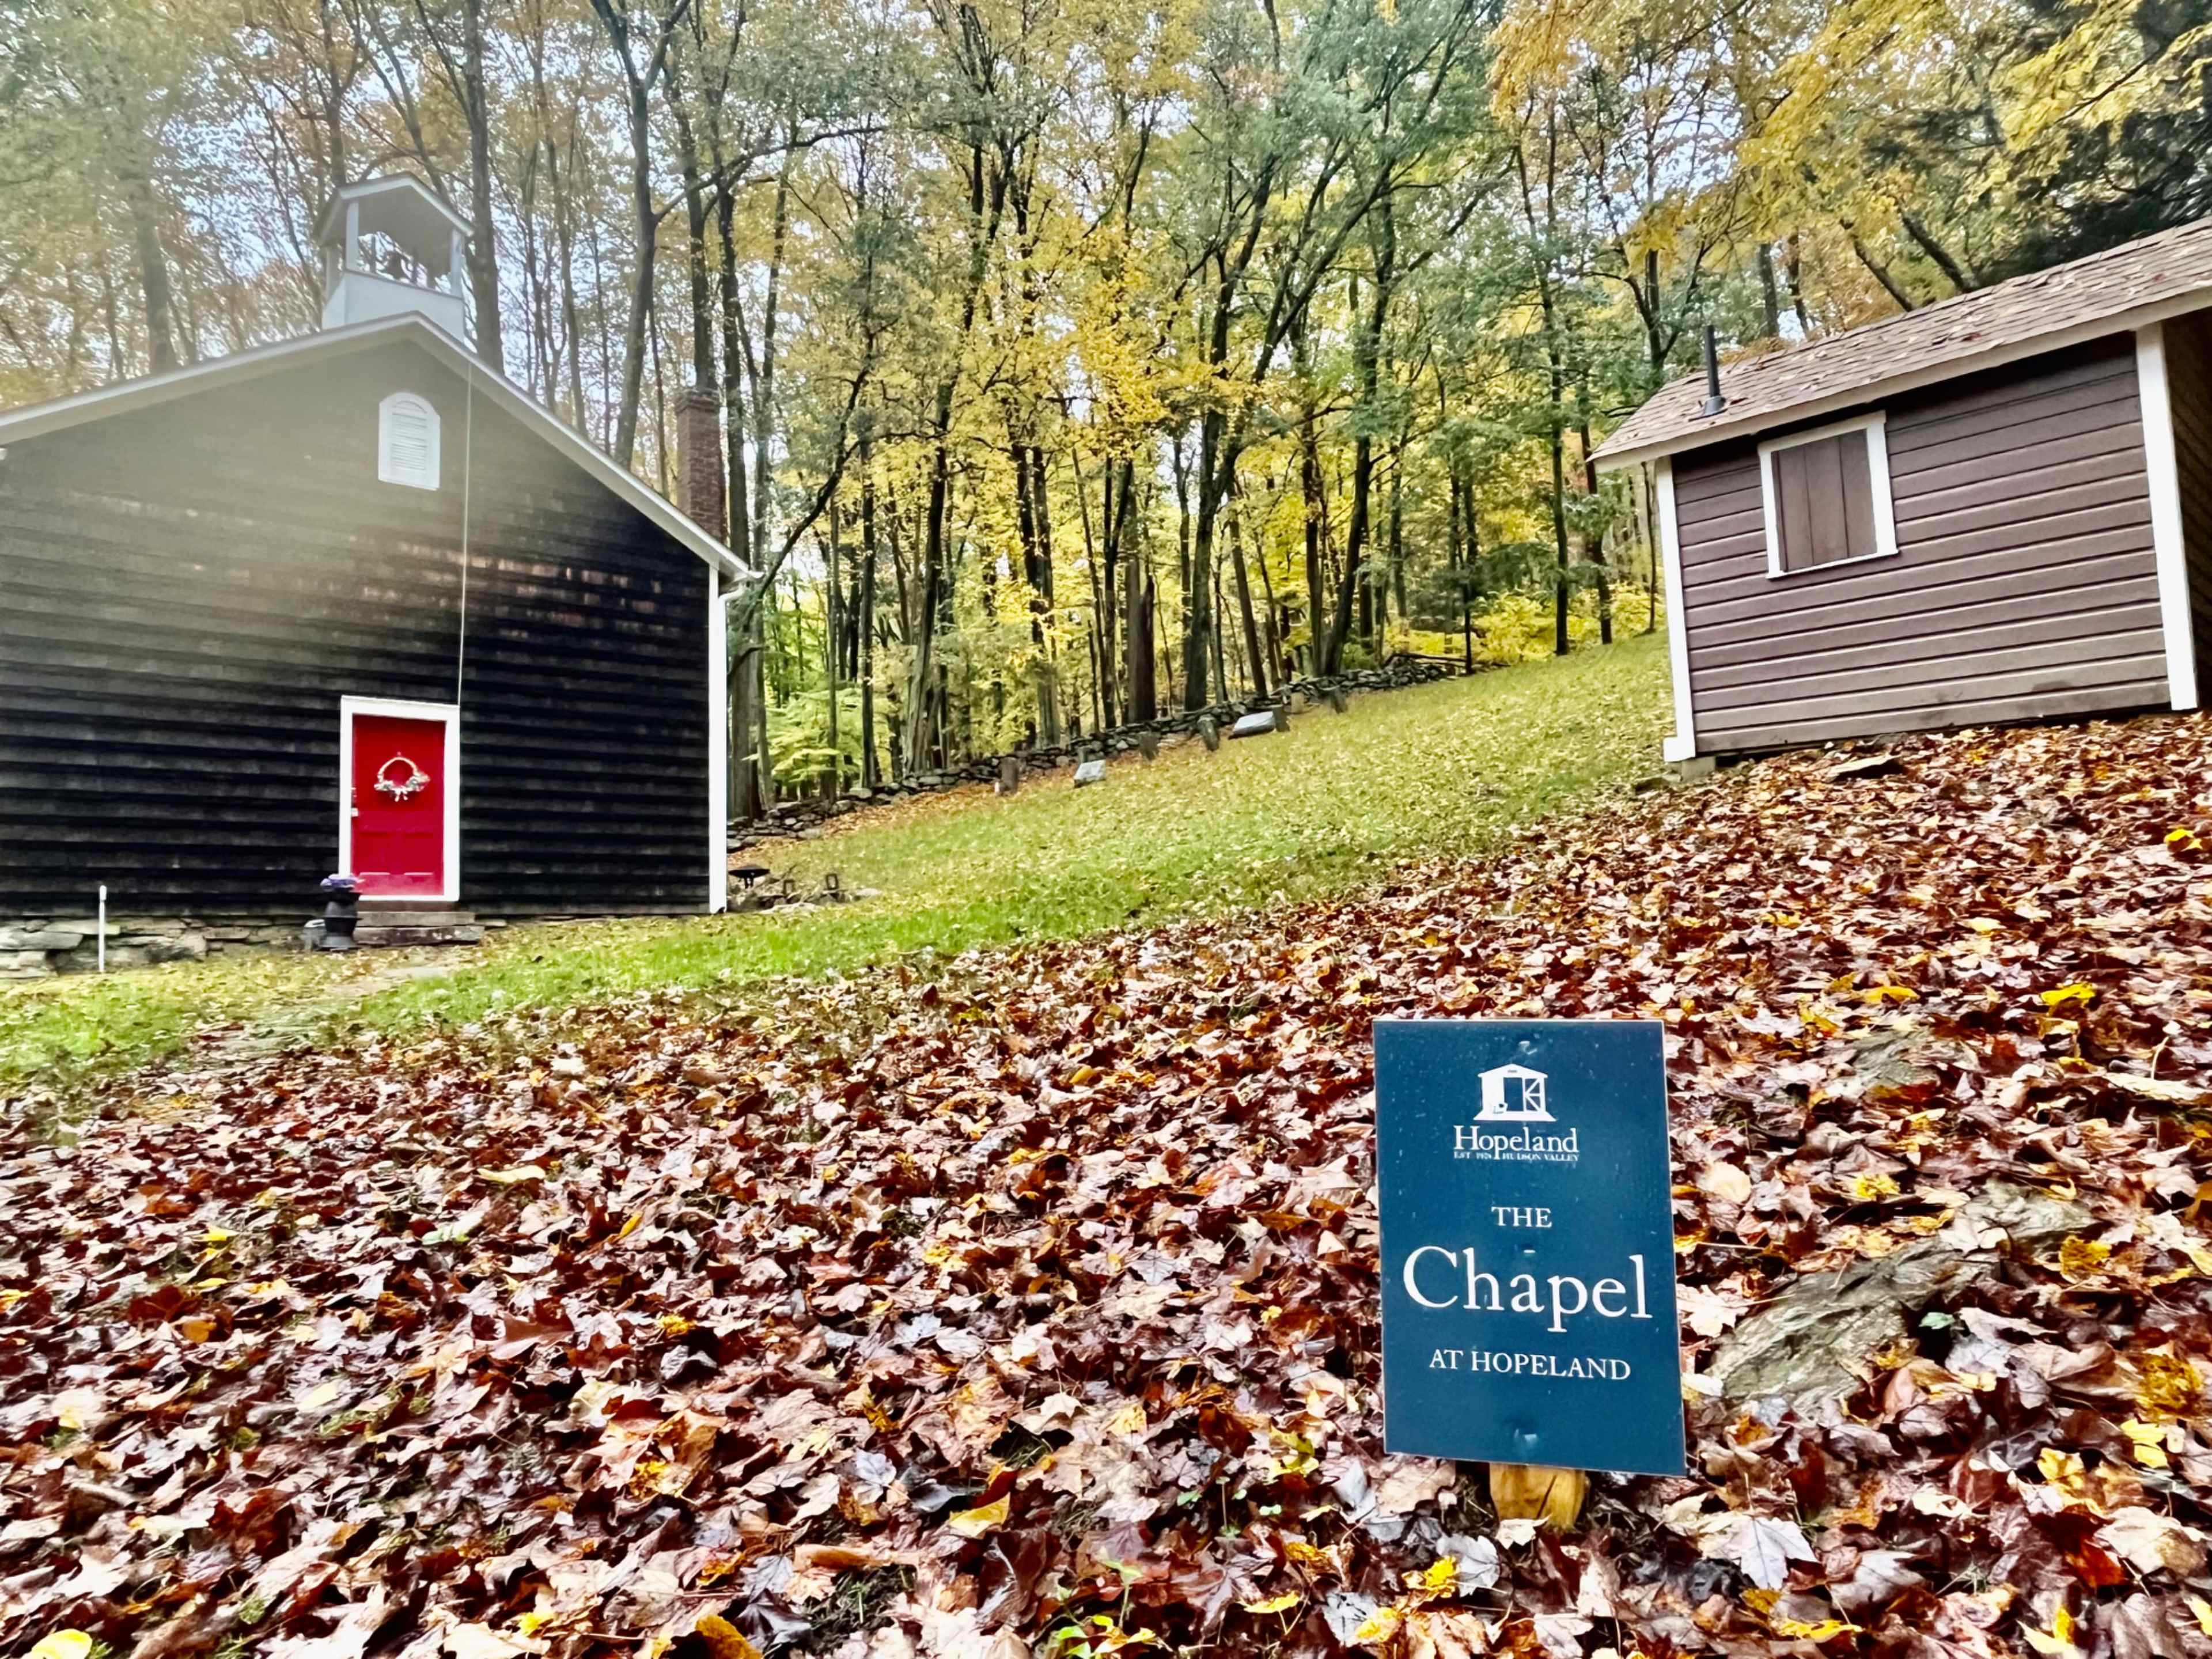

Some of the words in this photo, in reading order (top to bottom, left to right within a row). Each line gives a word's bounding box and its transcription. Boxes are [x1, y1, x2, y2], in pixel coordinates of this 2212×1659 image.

[1453, 1125, 1579, 1160] Hopeland
[1491, 1206, 1552, 1228] THE
[1403, 1246, 1653, 1333] Chapel
[1429, 1349, 1464, 1370] AT
[1471, 1351, 1631, 1380] HOPELAND
